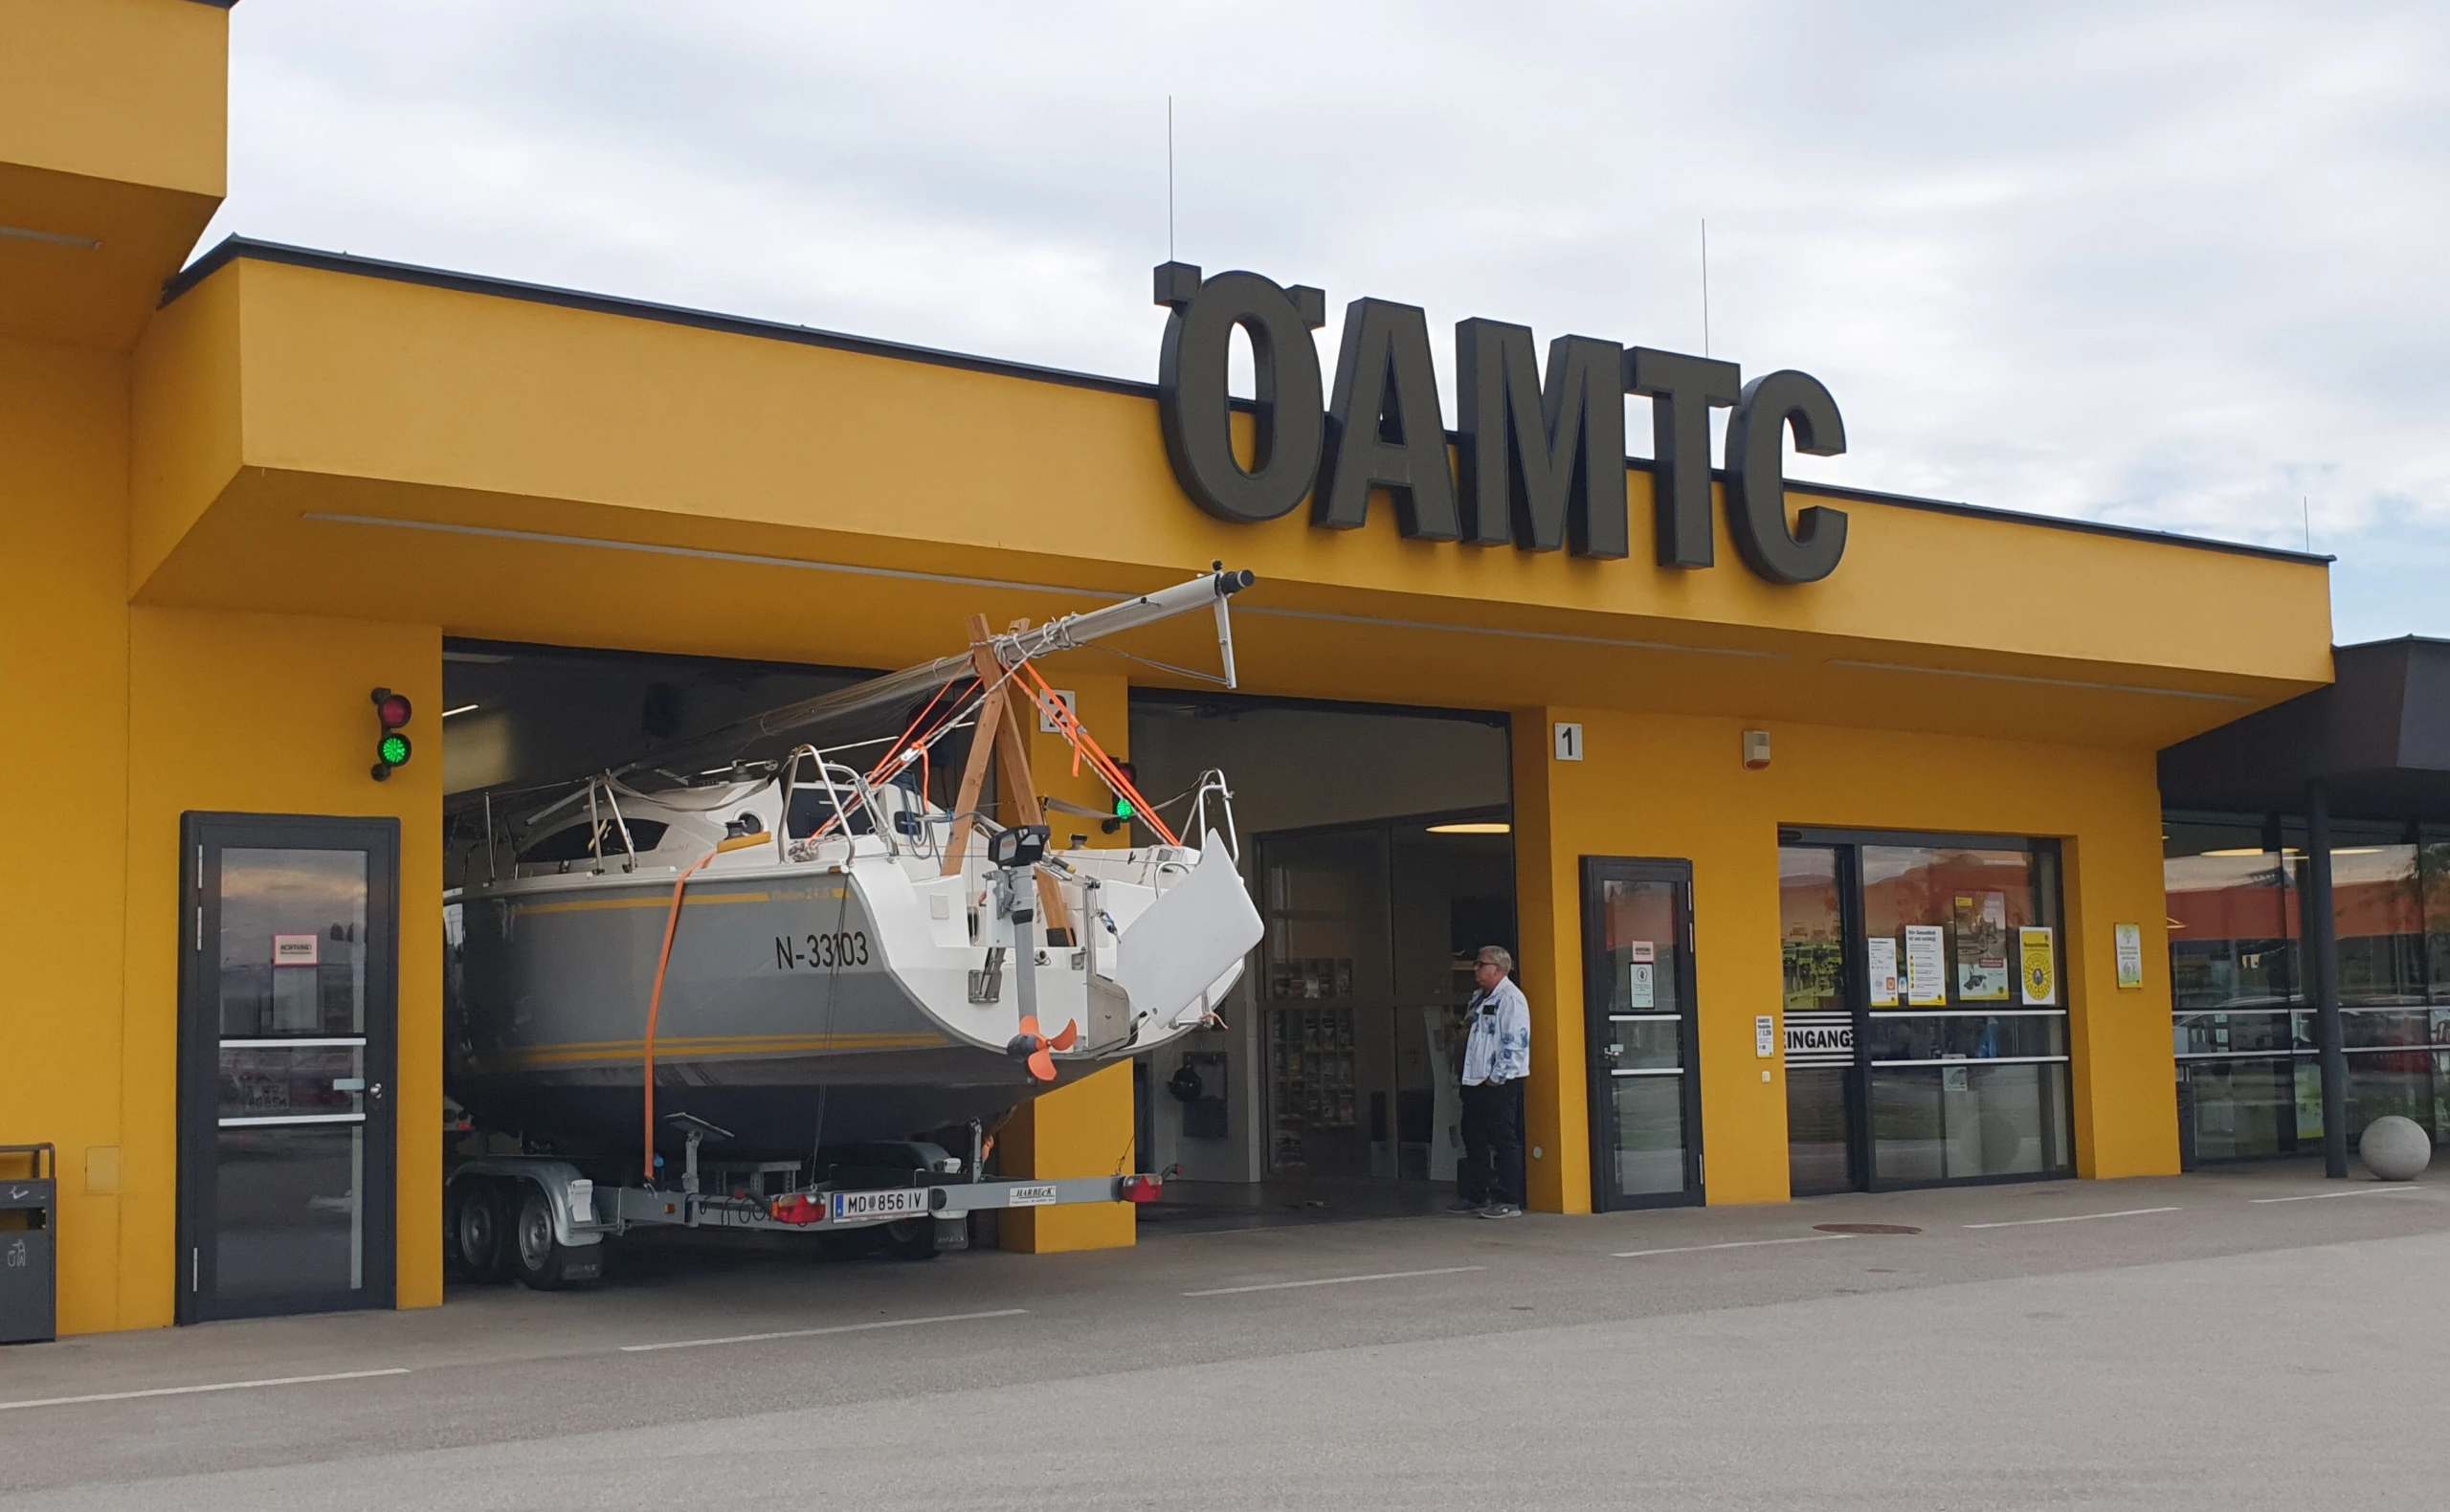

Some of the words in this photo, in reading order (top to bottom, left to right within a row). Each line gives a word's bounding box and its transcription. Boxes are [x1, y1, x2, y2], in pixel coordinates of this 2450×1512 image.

[1154, 261, 1848, 584] ÖAMTC
[1562, 726, 1572, 756] 1
[775, 931, 869, 969] N-33103
[848, 1196, 866, 1214] MD
[878, 1193, 904, 1211] 856
[908, 1191, 922, 1209] IV
